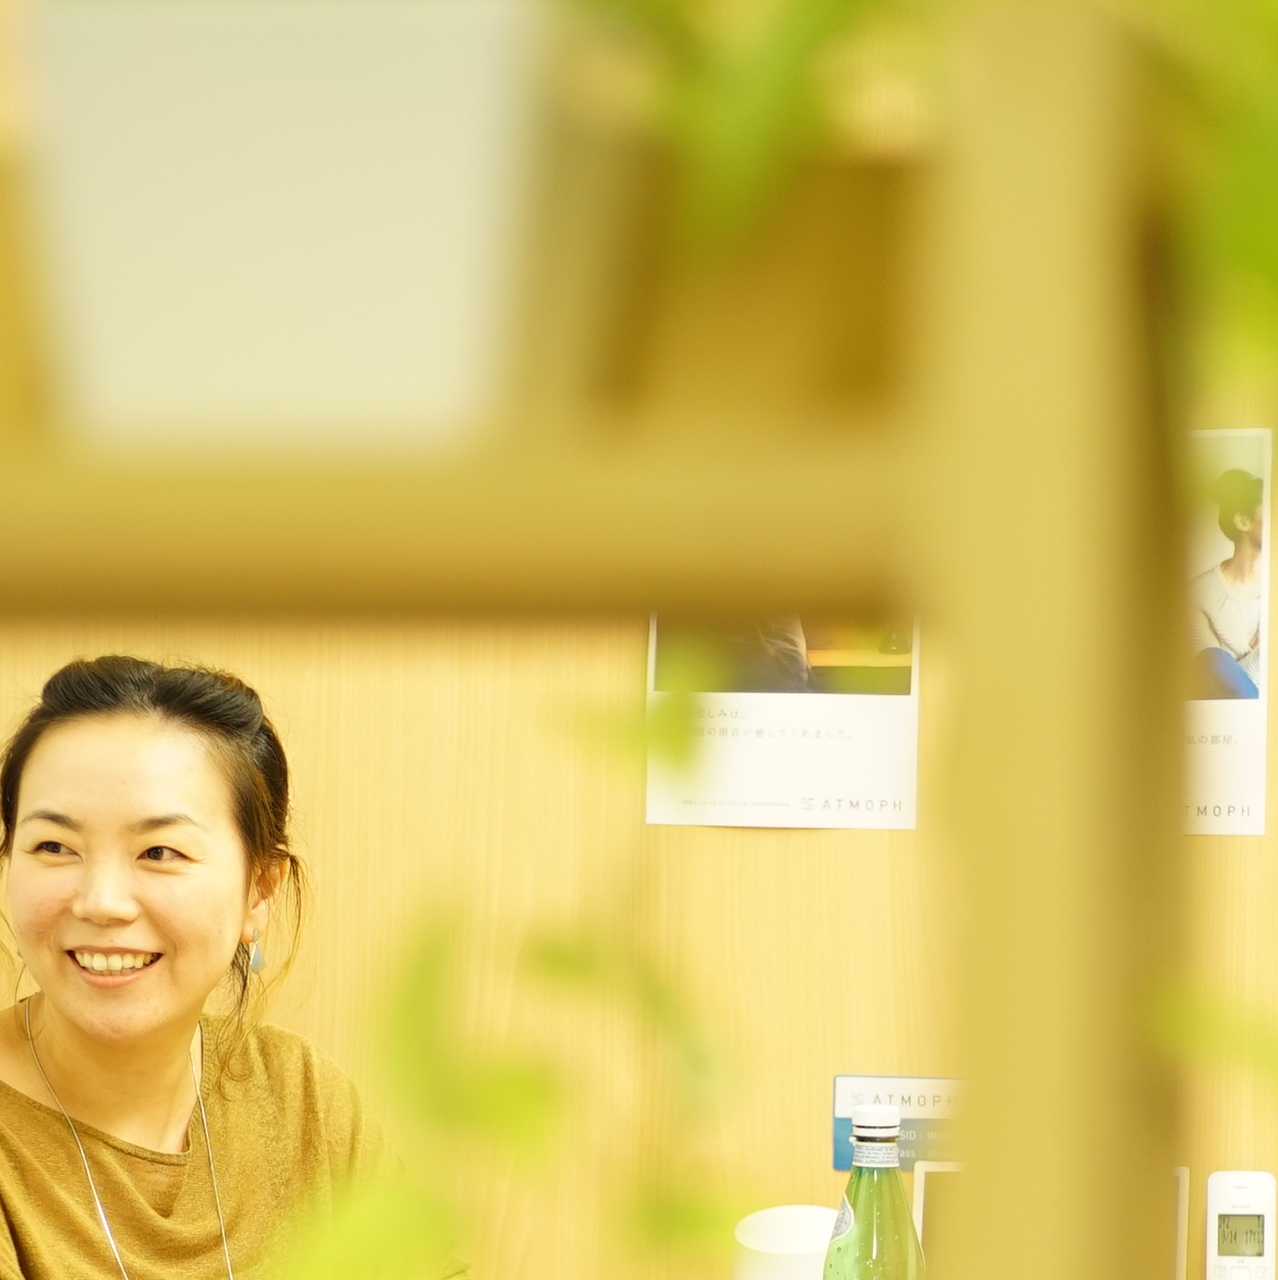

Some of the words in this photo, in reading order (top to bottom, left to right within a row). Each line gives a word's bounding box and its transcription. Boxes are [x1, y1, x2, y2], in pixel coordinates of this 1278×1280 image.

[822, 798, 903, 812] ATMOPH
[1183, 804, 1251, 817] TMOPH
[899, 1129, 917, 1141] SID
